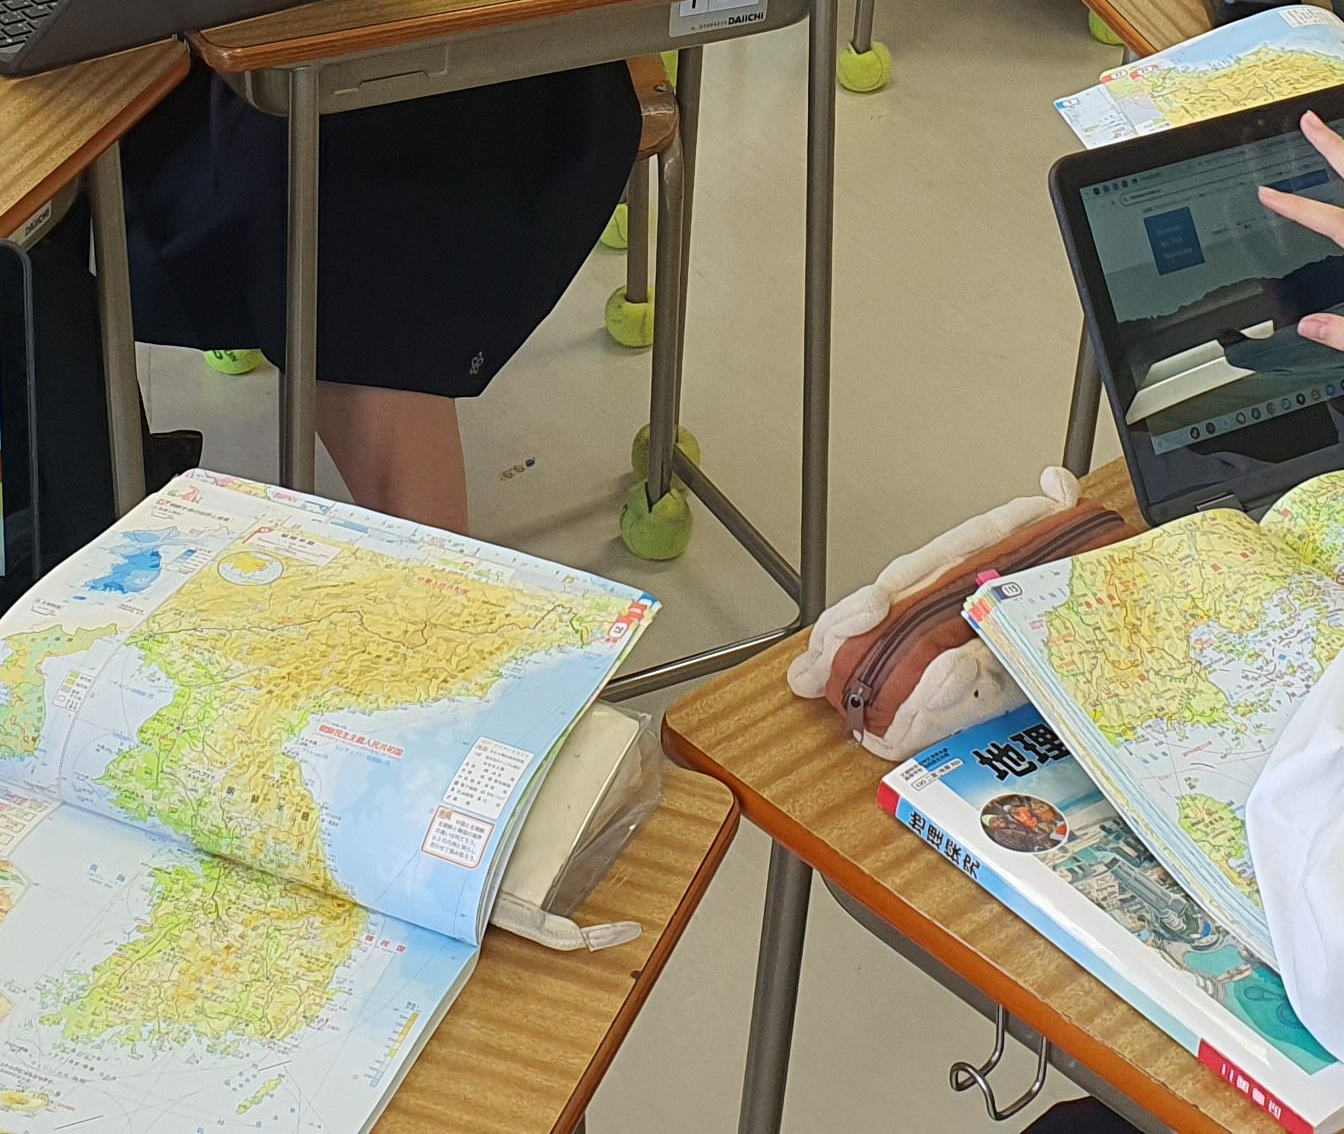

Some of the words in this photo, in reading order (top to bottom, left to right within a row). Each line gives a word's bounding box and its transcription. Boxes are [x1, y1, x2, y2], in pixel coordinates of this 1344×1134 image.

[728, 12, 764, 26] DAIICHI
[972, 723, 1071, 781] 地理
[909, 810, 980, 880] 地理探究
